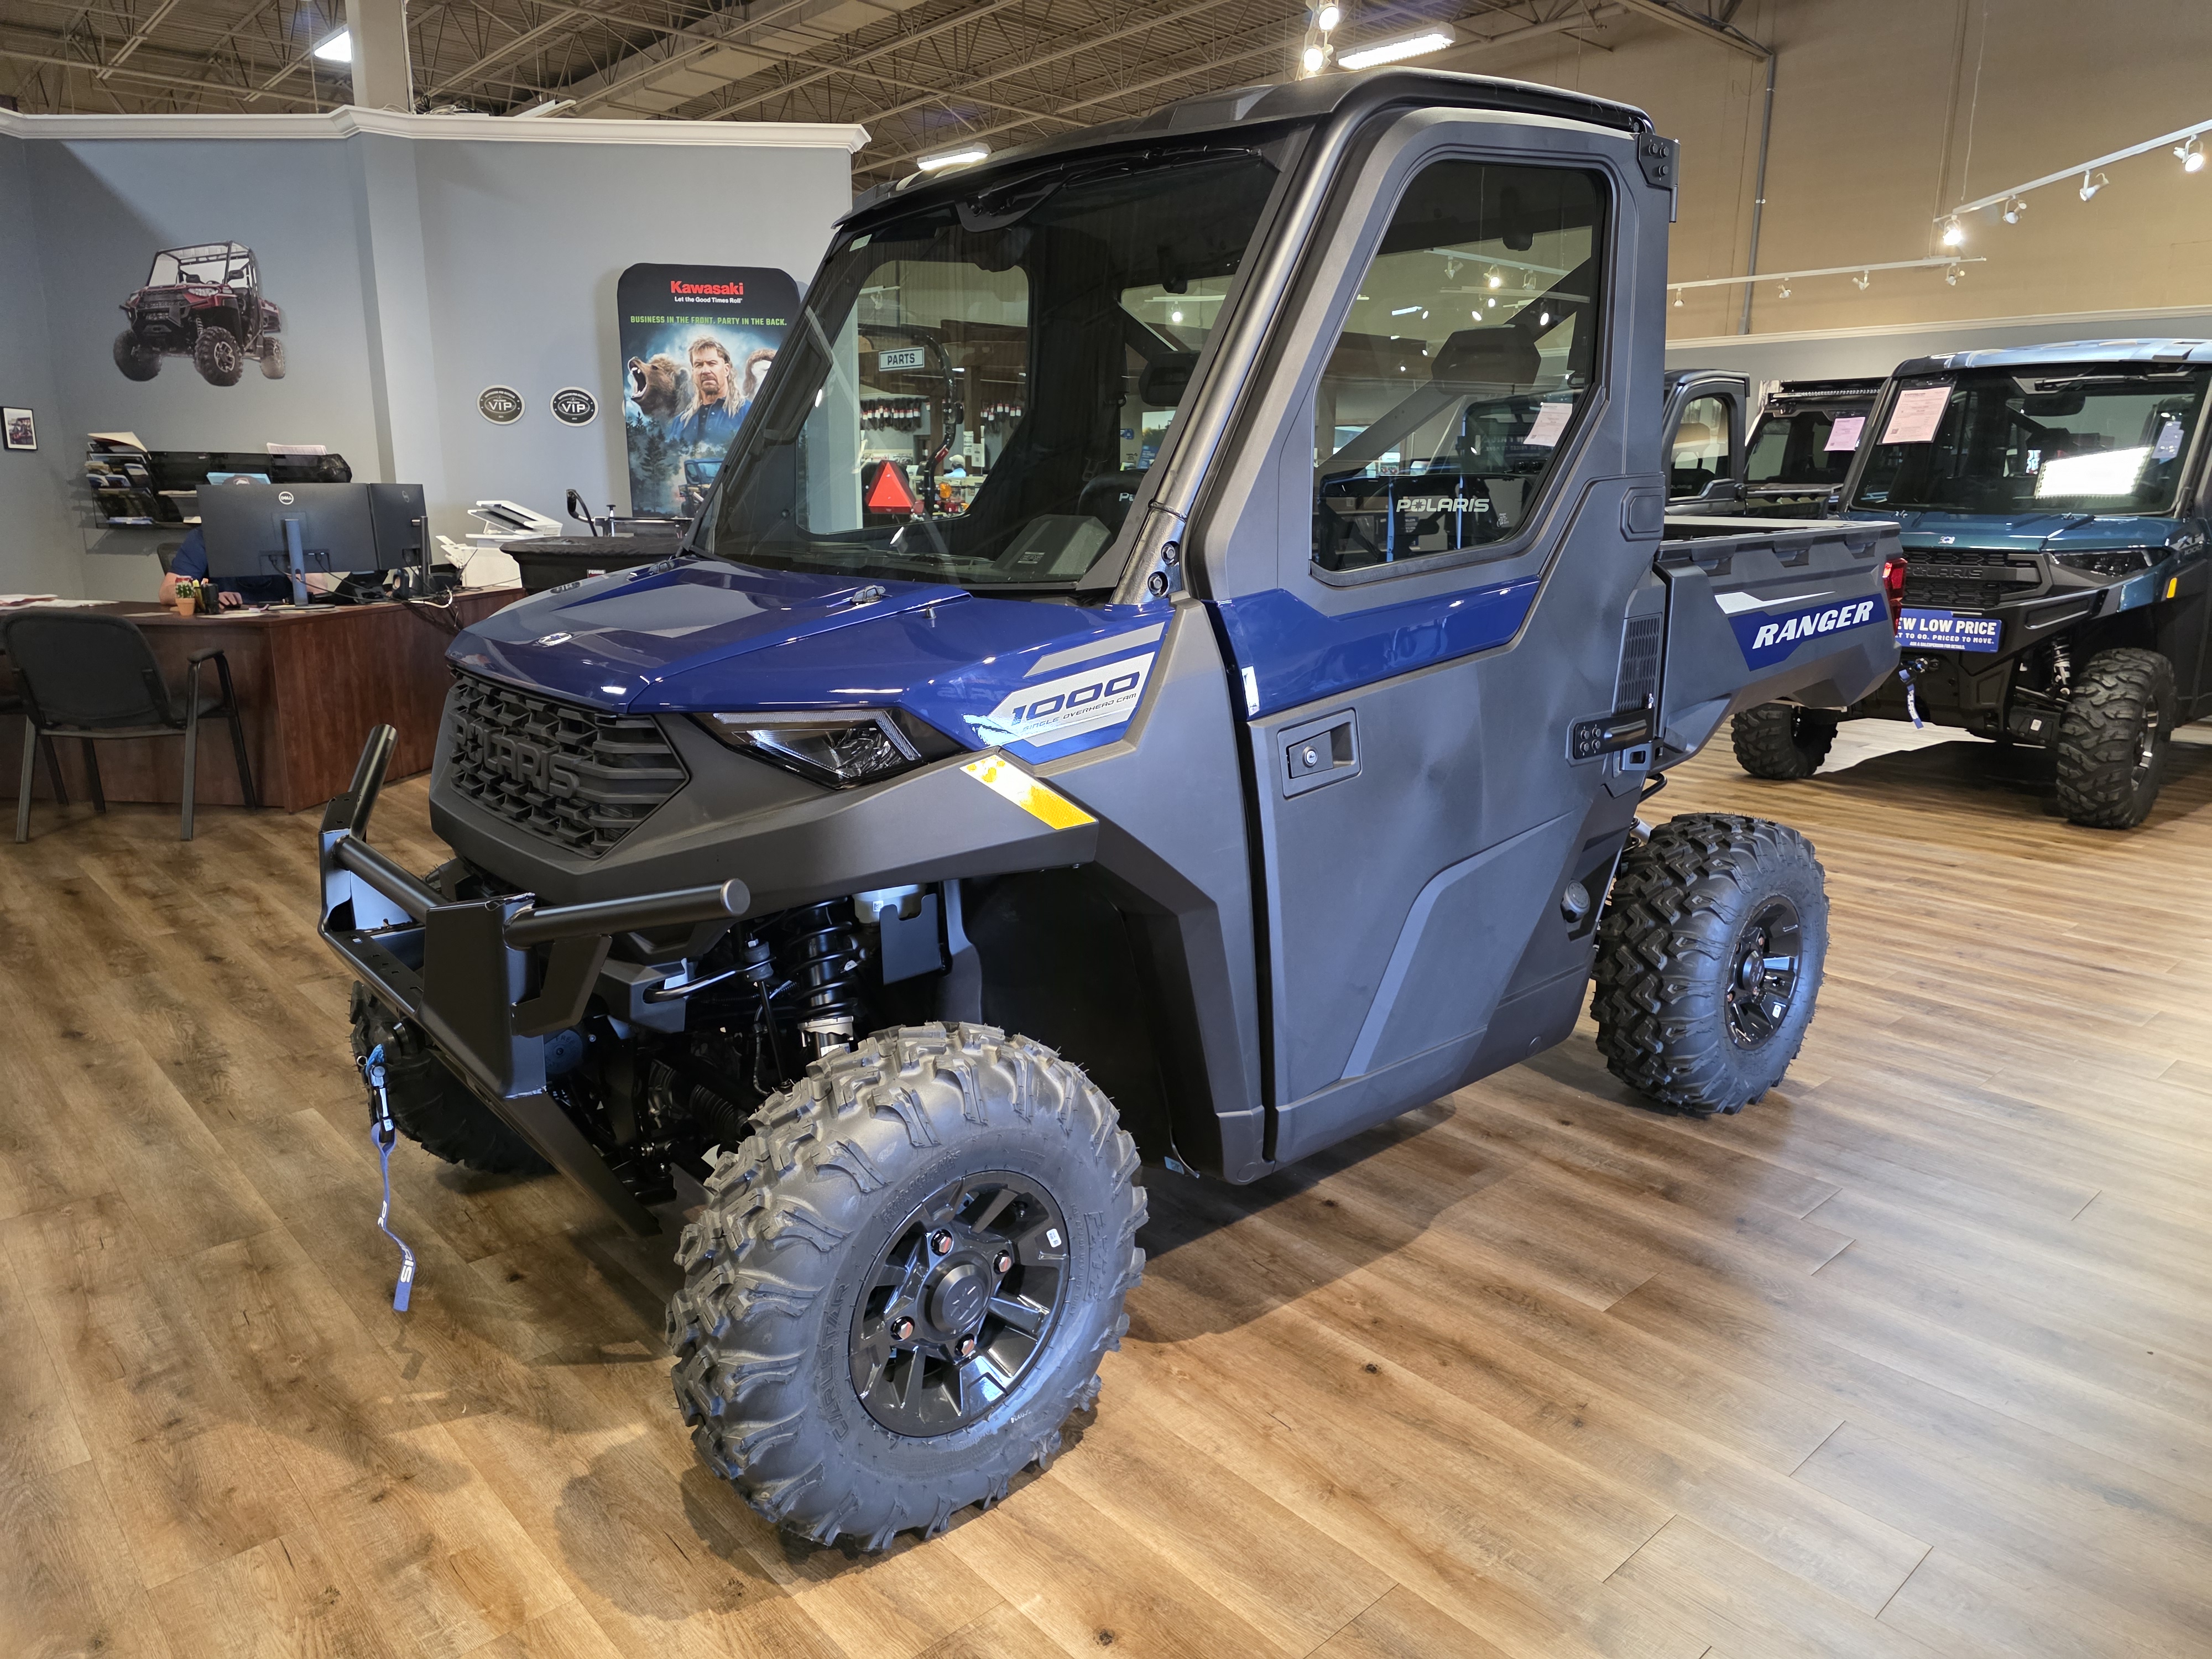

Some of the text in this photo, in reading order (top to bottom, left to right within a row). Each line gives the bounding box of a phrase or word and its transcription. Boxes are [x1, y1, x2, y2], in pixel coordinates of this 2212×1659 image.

[671, 280, 744, 295] Kawasaki
[888, 353, 915, 365] PARTS
[488, 401, 512, 410] VIP
[562, 403, 586, 413] VIP
[1396, 498, 1489, 512] POLARIS
[1752, 601, 1874, 649] RANGER
[1919, 618, 1953, 633] LOW
[1955, 620, 1997, 635] PRICE
[1011, 671, 1140, 726] 1000
[1023, 693, 1136, 731] SINGLE OVERHEAD CAM
[451, 713, 578, 799] POLARIS
